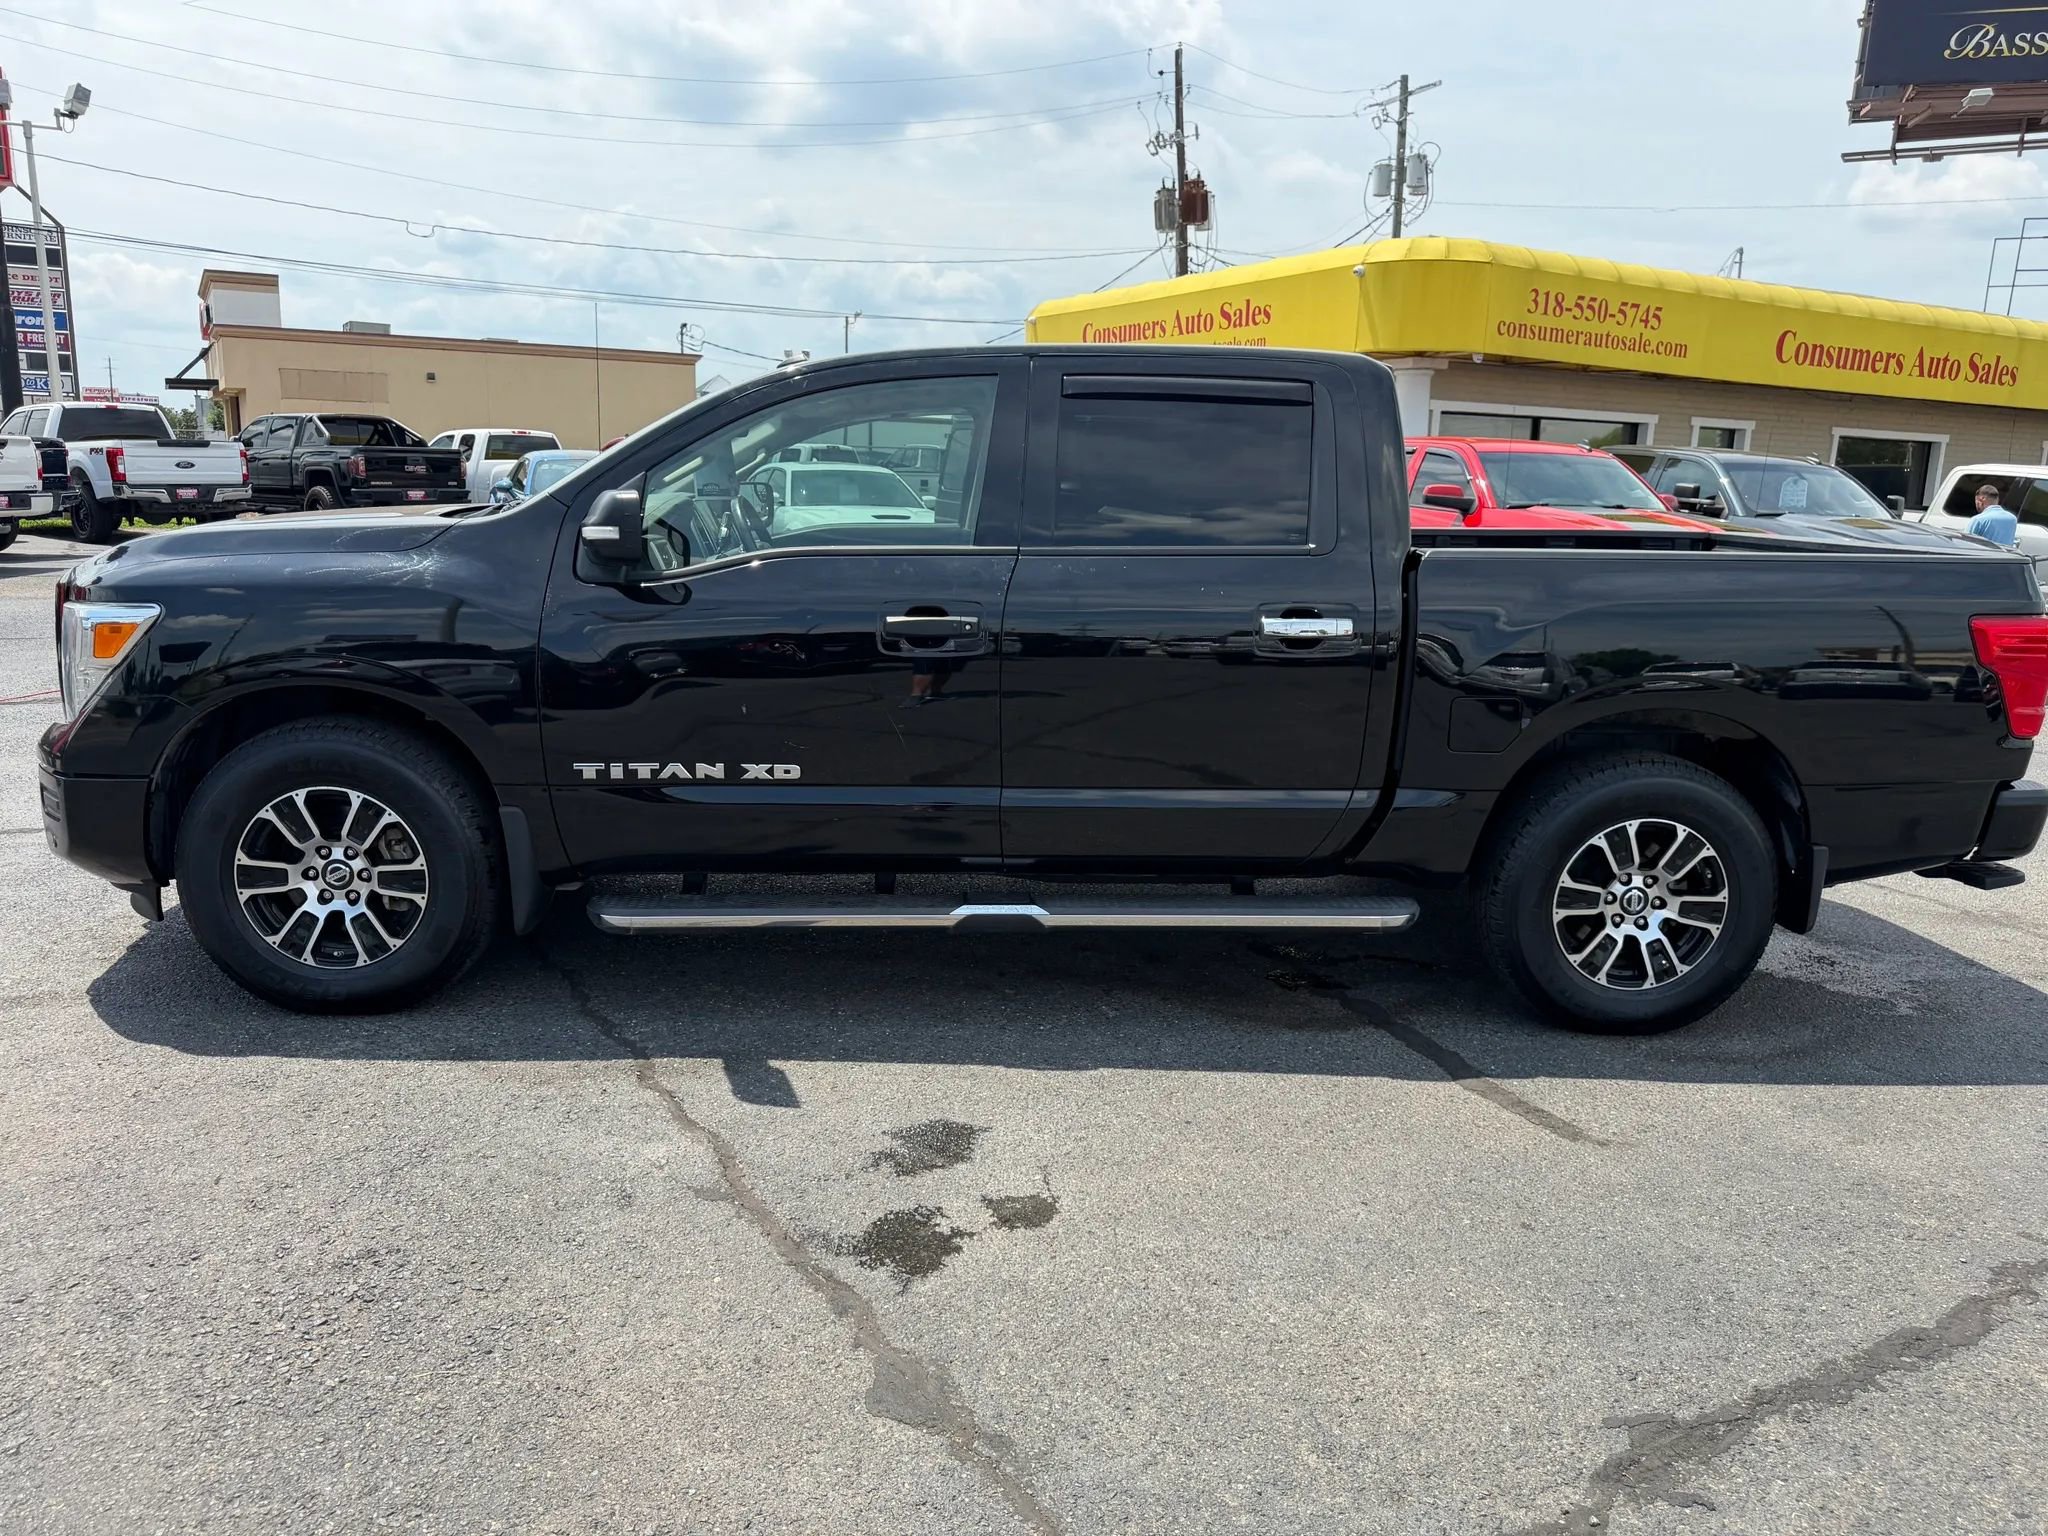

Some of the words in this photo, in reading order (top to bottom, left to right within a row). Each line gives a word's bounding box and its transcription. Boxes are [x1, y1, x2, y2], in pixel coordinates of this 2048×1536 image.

[1082, 319, 1167, 344] Consumers
[1171, 308, 1214, 337] Auto
[1218, 298, 1273, 330] Sales
[1527, 287, 1663, 331] 318-550-5745
[1497, 319, 1688, 359] consumerautosale.com
[1775, 328, 1906, 376] Consumers
[1908, 346, 1962, 382] Auto
[1963, 351, 2019, 387] Sales
[573, 762, 725, 780] TITAN
[739, 763, 801, 780] XD
